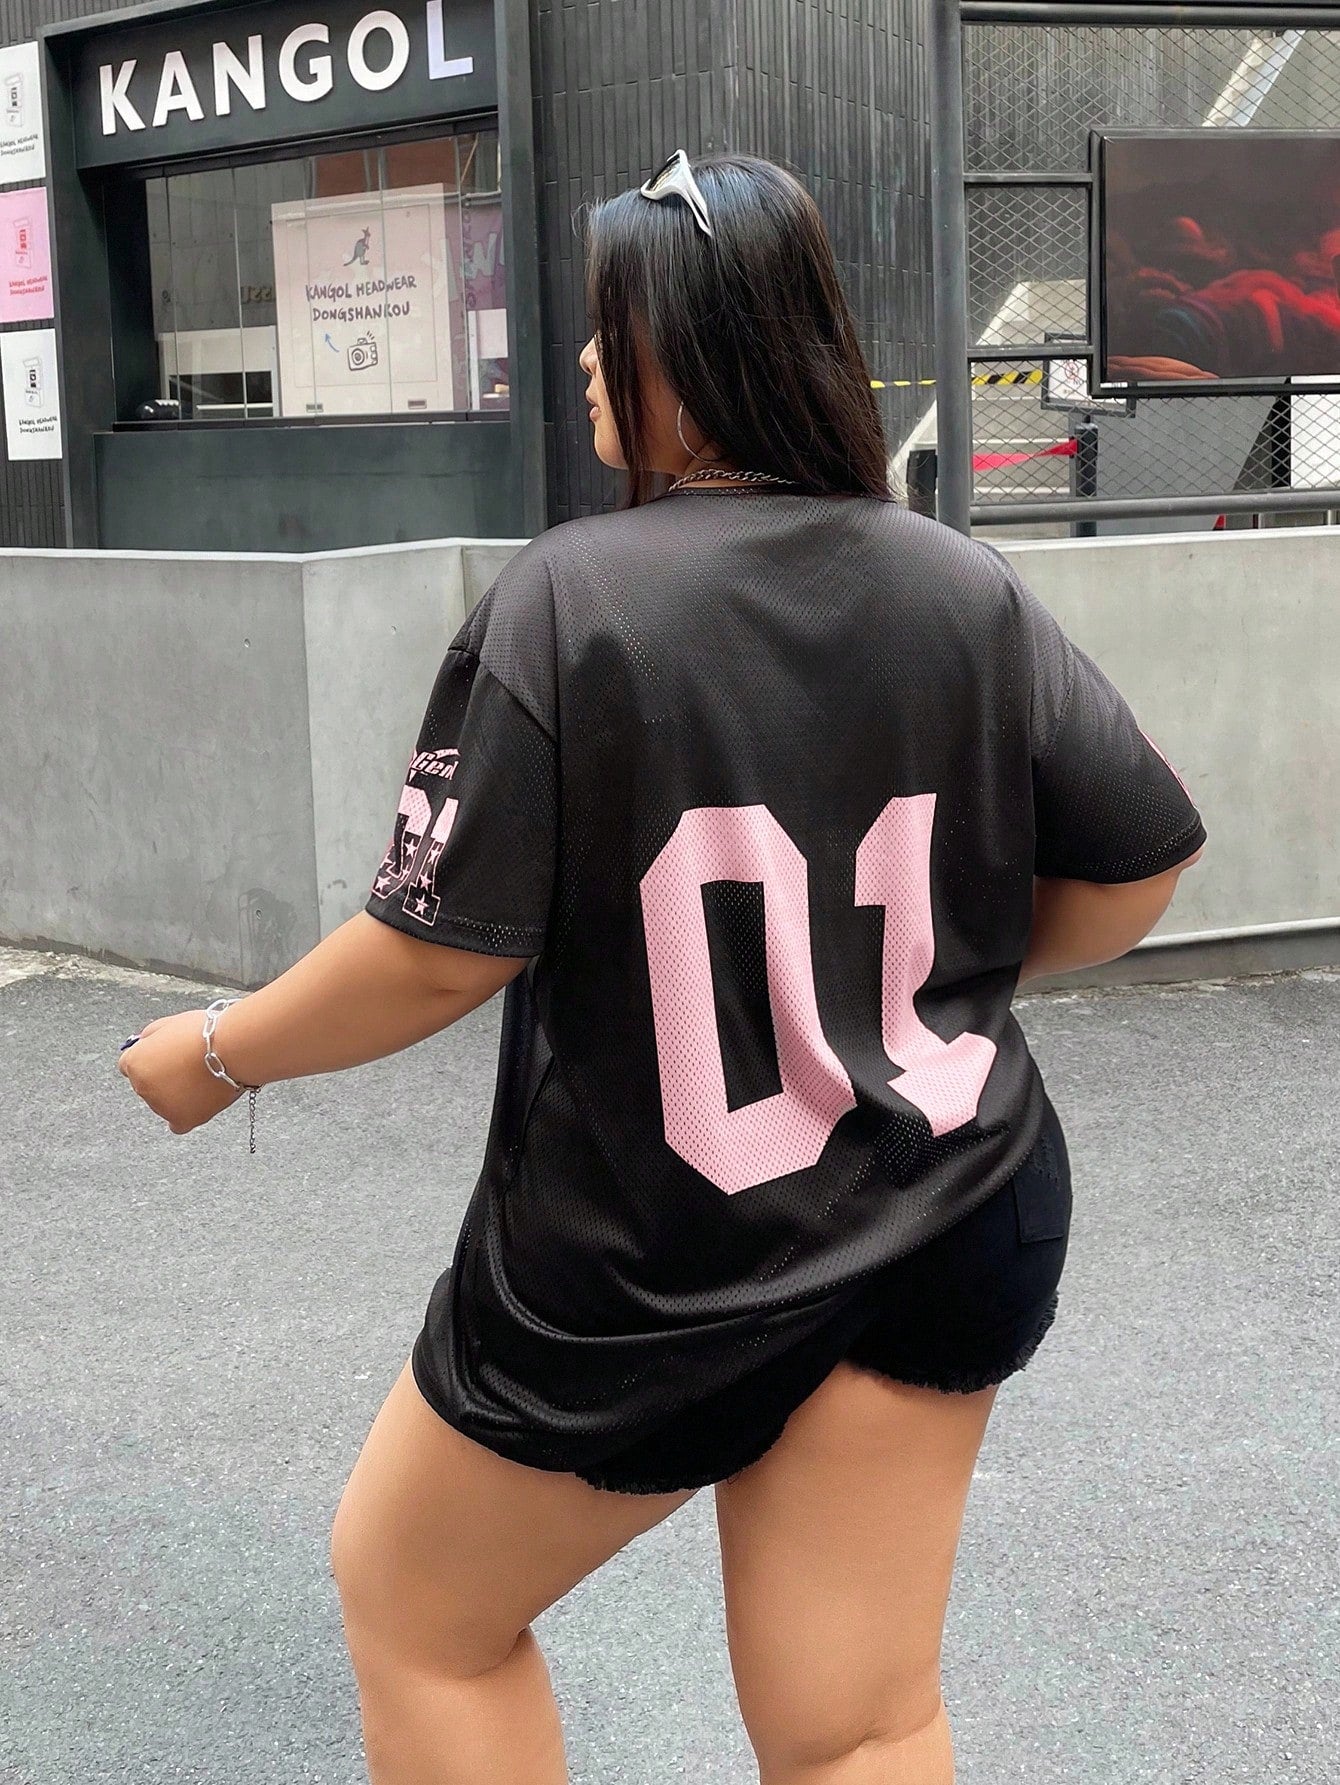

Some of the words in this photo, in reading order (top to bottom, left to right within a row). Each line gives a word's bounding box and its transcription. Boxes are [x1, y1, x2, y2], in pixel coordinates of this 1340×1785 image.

[99, 0, 474, 136] KANGOL
[305, 283, 352, 303] KANGOL
[356, 275, 417, 297] HEADWEAR
[312, 301, 411, 322] DONGSHANKOU
[639, 793, 998, 1196] 01
